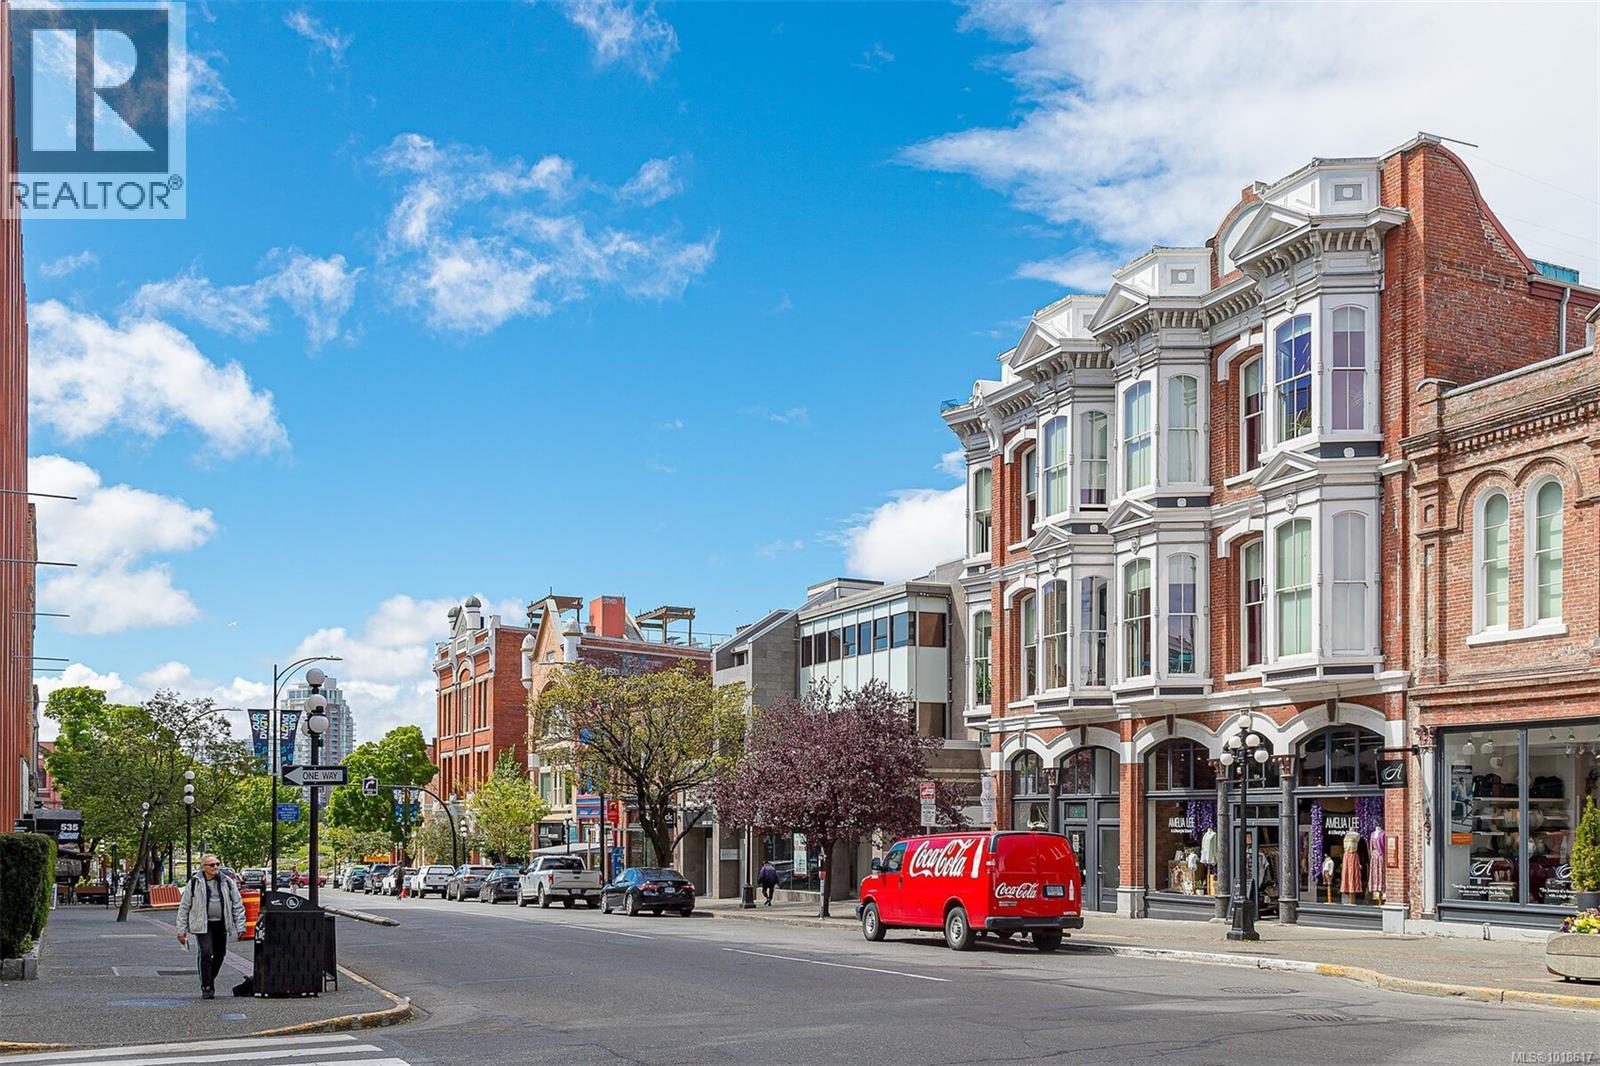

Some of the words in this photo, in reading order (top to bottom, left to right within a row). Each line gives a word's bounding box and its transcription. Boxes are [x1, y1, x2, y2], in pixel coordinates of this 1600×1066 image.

[302, 771, 319, 780] ONE
[322, 771, 338, 780] WAY
[60, 823, 79, 831] 535
[1168, 817, 1186, 828] AMELIA
[1186, 817, 1195, 828] LEE
[1325, 817, 1348, 829] AMELIA
[1348, 817, 1360, 829] LEE
